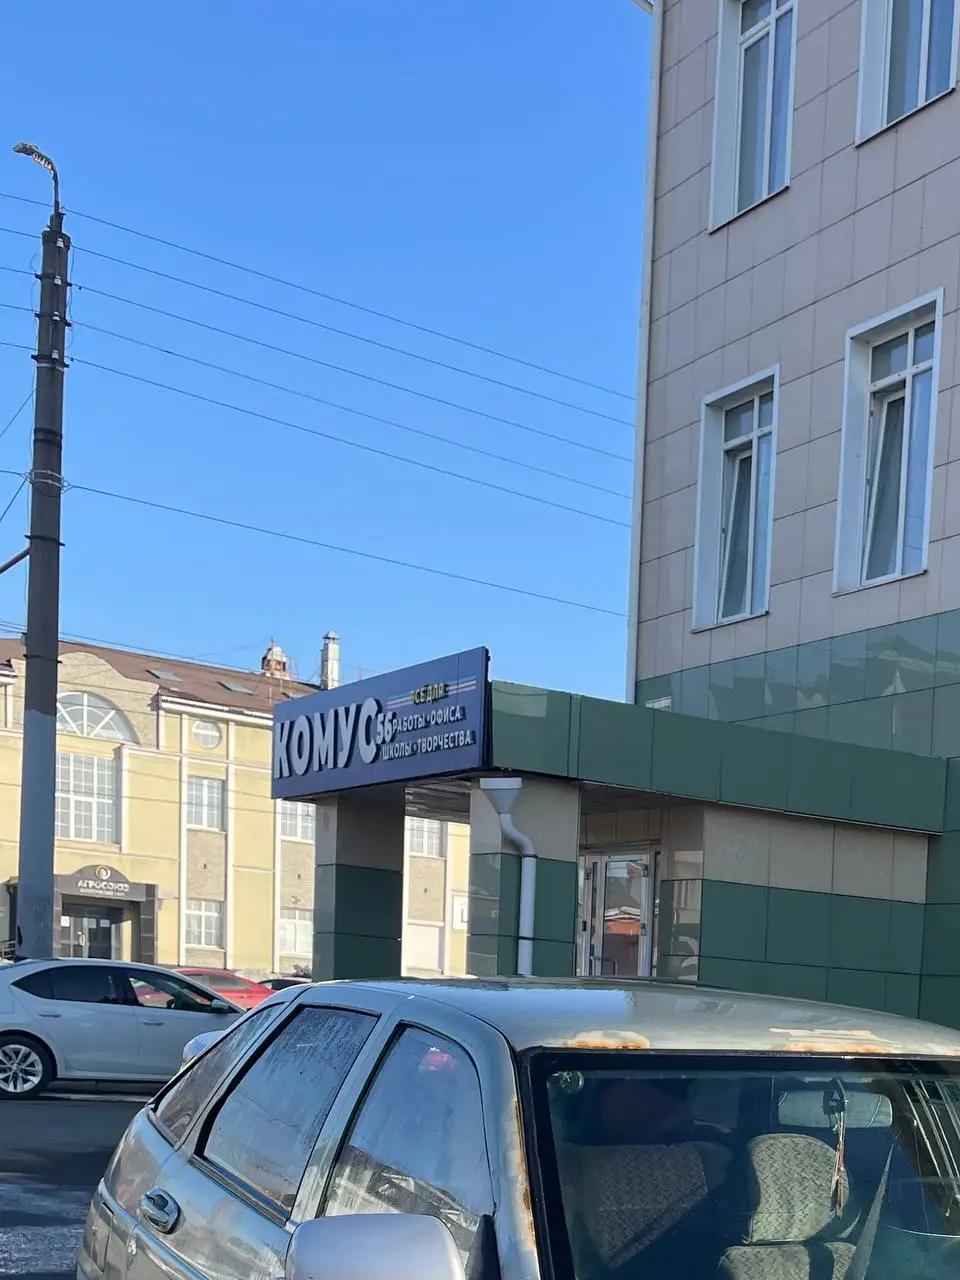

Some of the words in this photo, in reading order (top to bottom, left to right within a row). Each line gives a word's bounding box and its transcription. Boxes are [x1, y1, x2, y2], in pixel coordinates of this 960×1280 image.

[426, 683, 445, 703] ДЛЯ
[393, 712, 425, 734] РАБОТЫ
[430, 704, 461, 726] ОФИСА
[275, 697, 379, 779] КОМУС
[376, 711, 394, 744] 56
[382, 740, 412, 760] ШКОЛЫ
[417, 729, 472, 753] ТВОРЧЕСТВА
